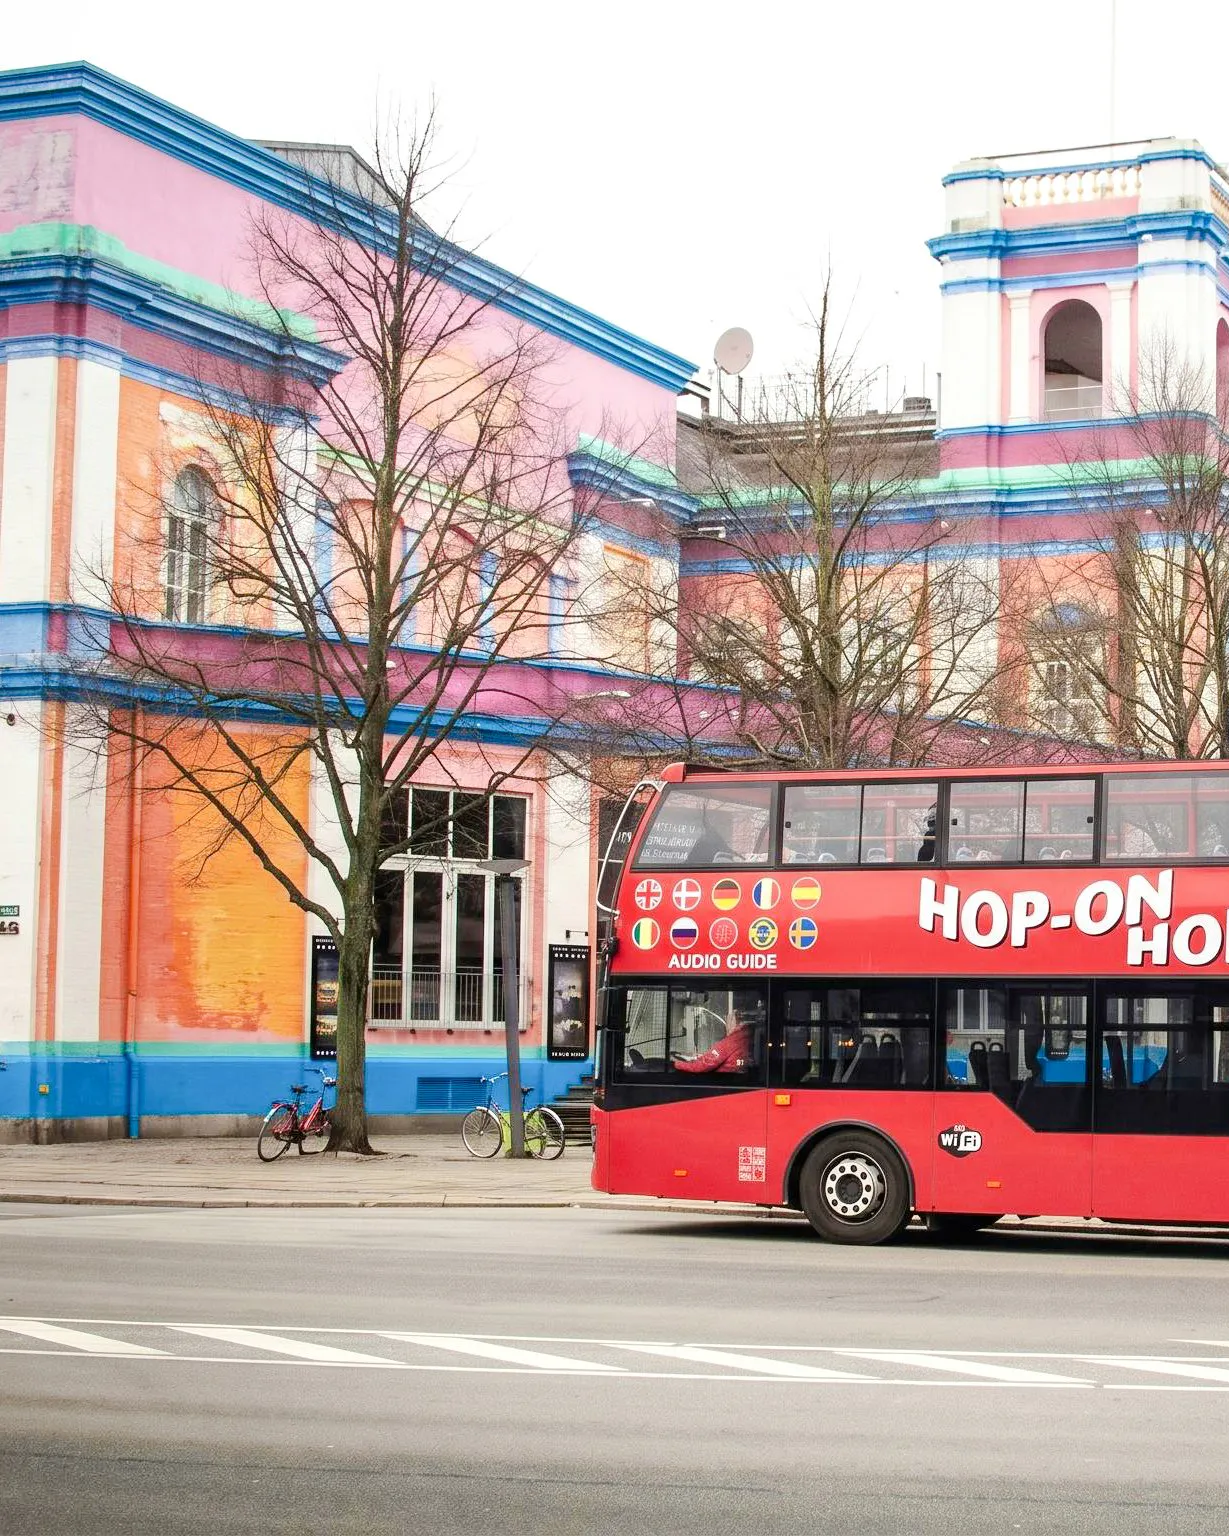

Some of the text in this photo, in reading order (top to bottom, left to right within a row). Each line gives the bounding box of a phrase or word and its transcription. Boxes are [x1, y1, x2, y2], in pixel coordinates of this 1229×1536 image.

[918, 869, 1174, 948] HOP-ON
[668, 953, 778, 969] AUDIO GUIDE
